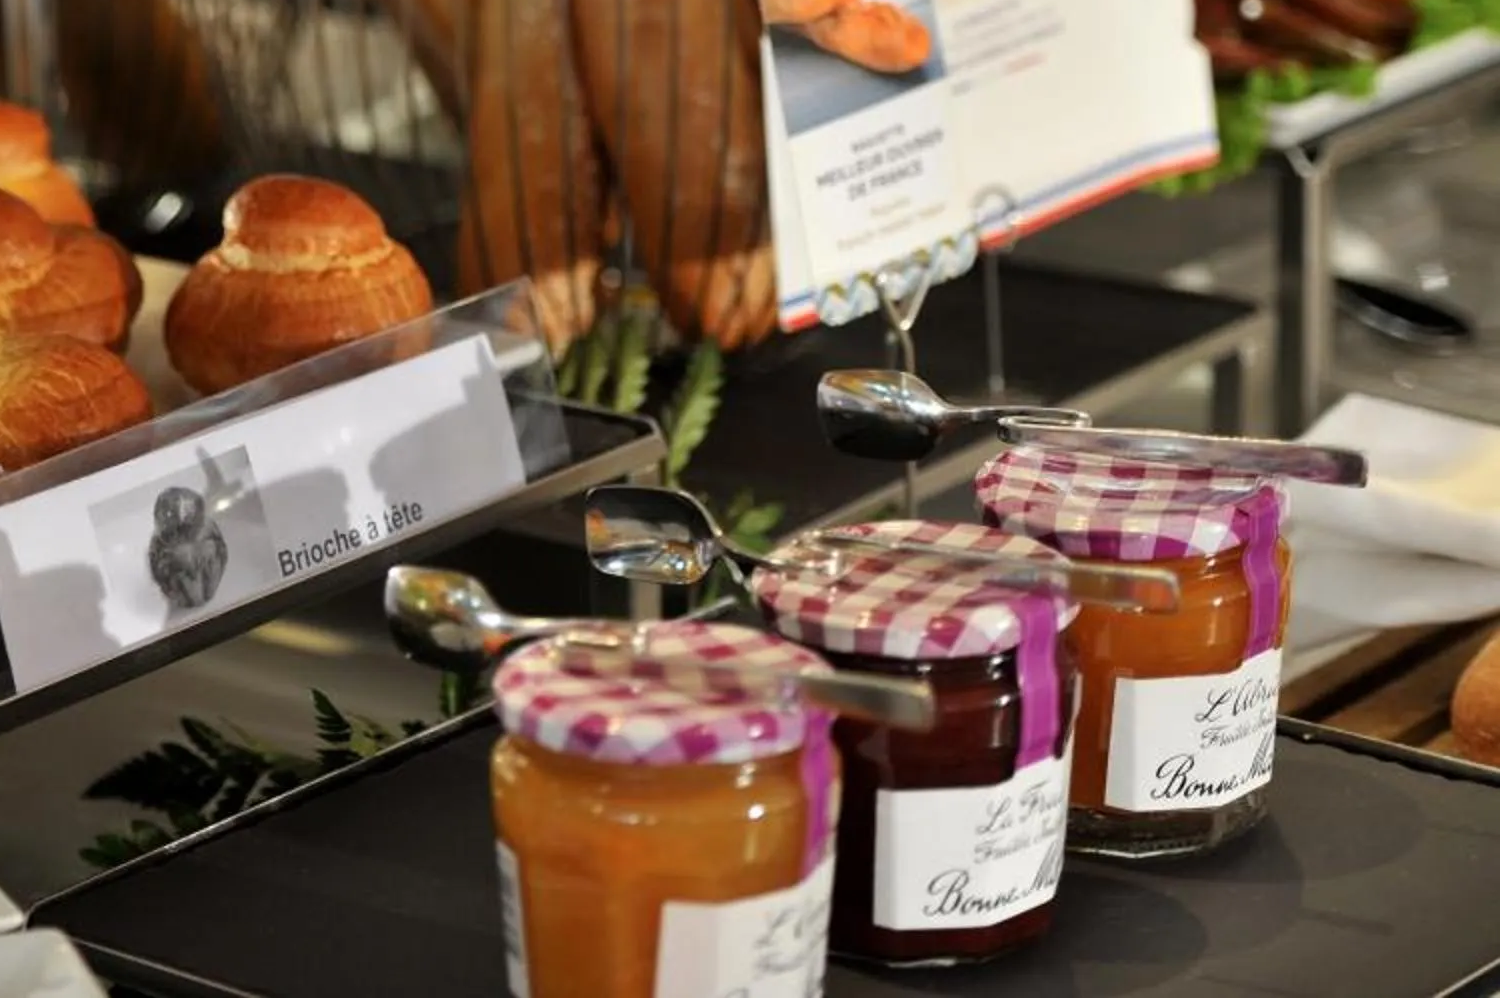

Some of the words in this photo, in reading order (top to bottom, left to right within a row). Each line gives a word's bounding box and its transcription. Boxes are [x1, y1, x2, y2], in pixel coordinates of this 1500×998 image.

[277, 527, 362, 578] Brioche
[366, 513, 380, 541] à
[383, 501, 424, 534] tête
[1149, 753, 1239, 801] Bonne
[922, 868, 1019, 917] Bonne
